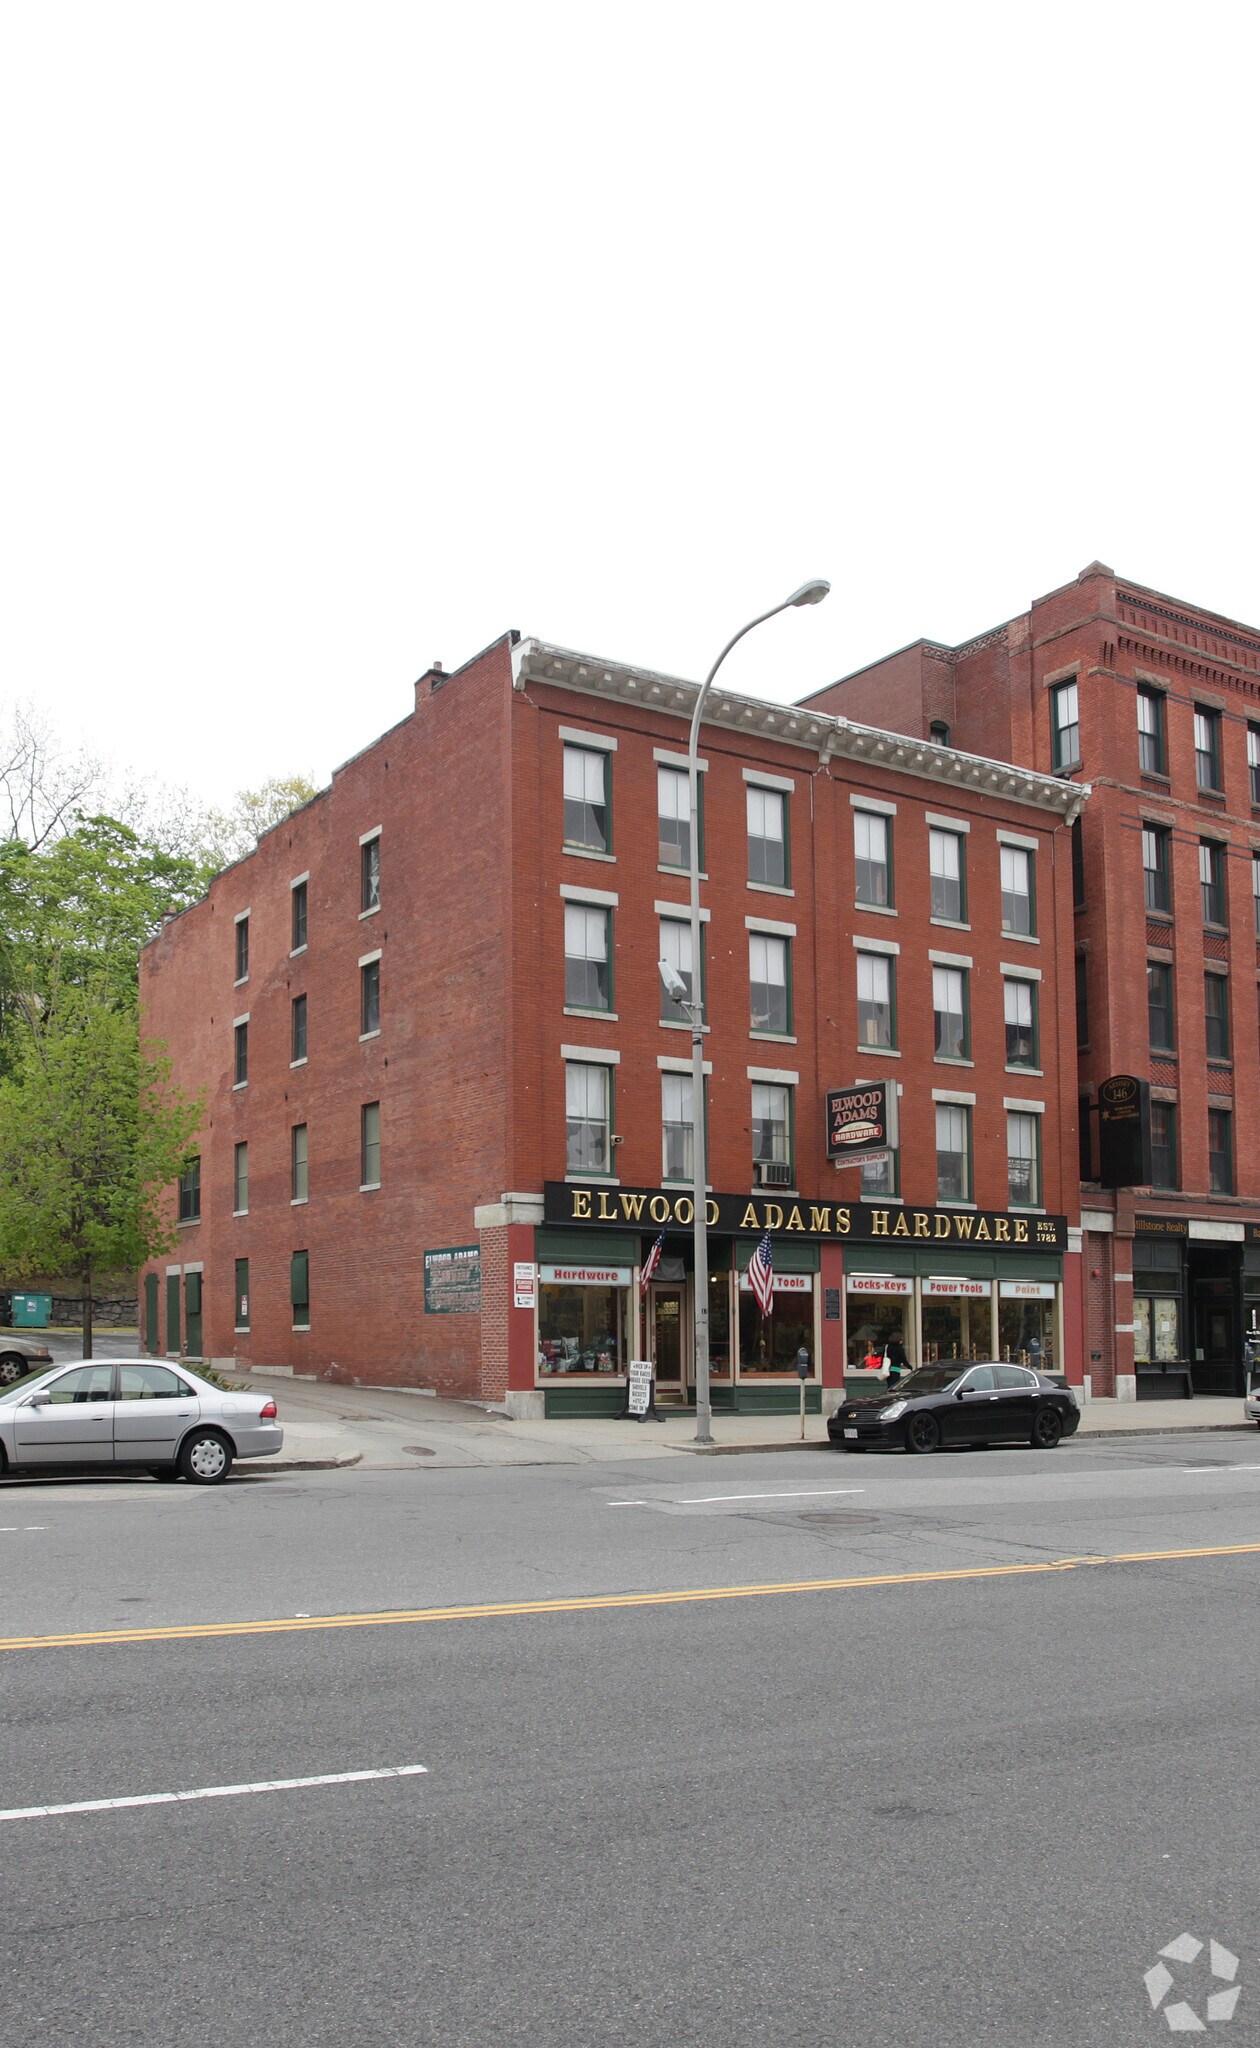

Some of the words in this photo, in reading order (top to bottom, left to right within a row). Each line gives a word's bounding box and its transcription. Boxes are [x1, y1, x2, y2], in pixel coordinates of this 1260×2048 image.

[1113, 1087, 1128, 1100] 146
[831, 1090, 882, 1113] ELWOOD
[834, 1106, 878, 1126] ADAMS
[835, 1127, 880, 1142] HARDWARE
[571, 1190, 720, 1226] ELWOOD
[739, 1202, 851, 1234] ADAMS
[870, 1210, 1029, 1243] HARDWARE
[1036, 1221, 1056, 1232] EST.
[1166, 1222, 1188, 1235] Realty
[1036, 1233, 1057, 1243] 1782
[554, 1269, 618, 1281] Hardware
[777, 1277, 805, 1288] Tools
[852, 1280, 907, 1291] Locks-Keys
[930, 1283, 957, 1292] Power
[960, 1283, 983, 1293] Tools
[1015, 1285, 1040, 1294] Paint
